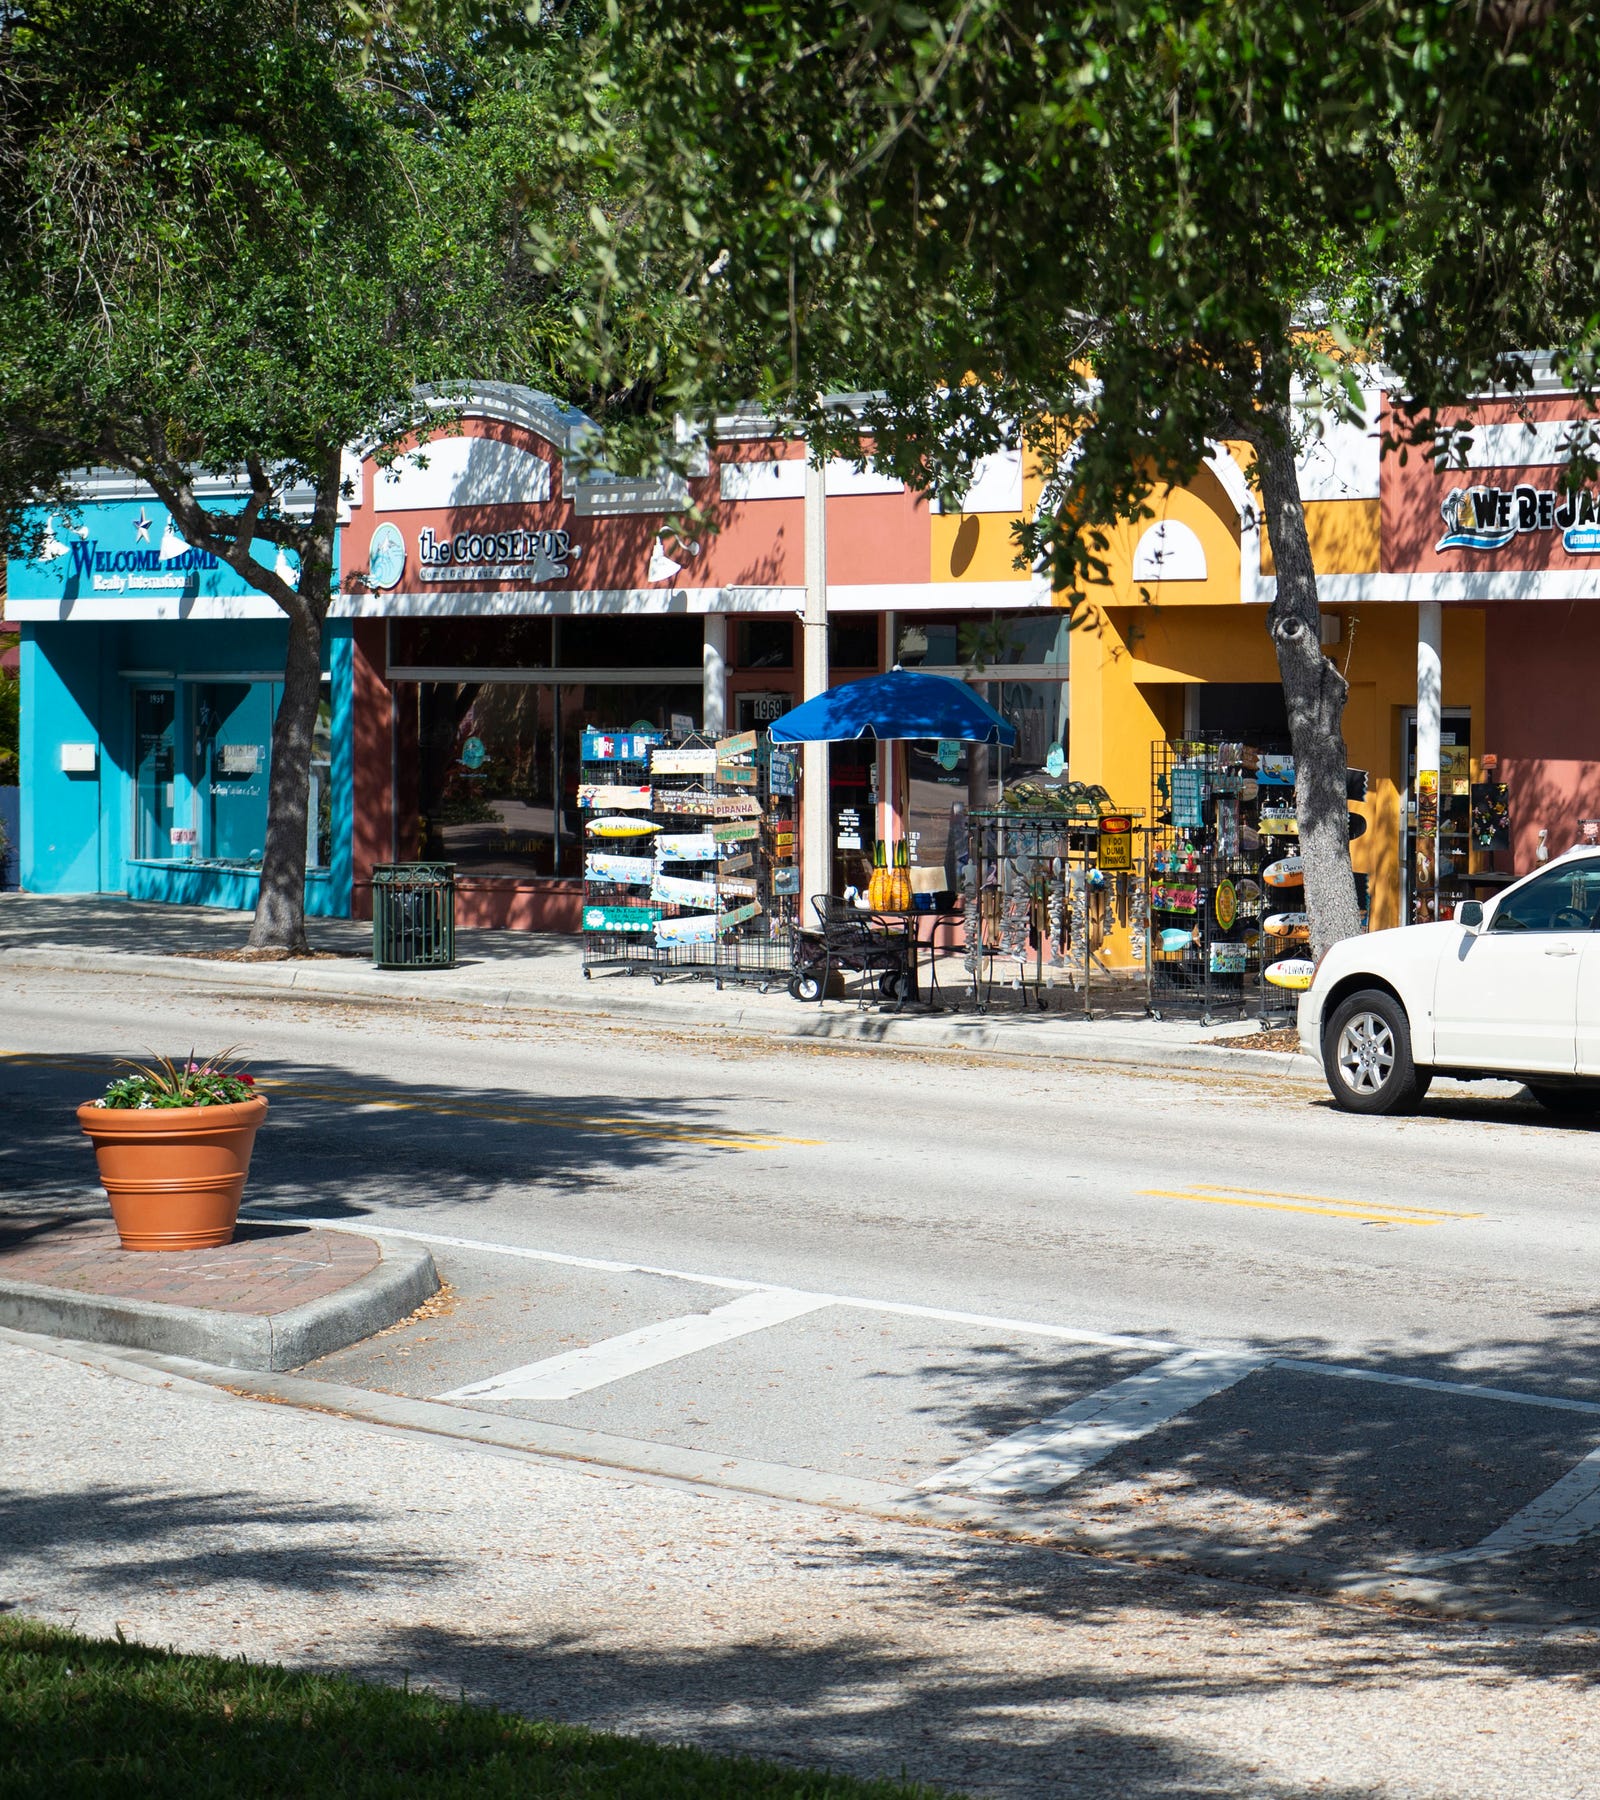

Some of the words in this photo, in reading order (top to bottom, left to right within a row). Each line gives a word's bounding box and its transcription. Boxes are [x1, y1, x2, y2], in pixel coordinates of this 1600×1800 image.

[1473, 489, 1513, 528] WE
[1517, 485, 1555, 528] BE
[420, 528, 449, 561] the
[453, 530, 523, 563] GOOSE
[1569, 534, 1595, 544] VETERAN
[70, 540, 161, 579] WELCOME
[165, 547, 219, 571] HOME
[93, 575, 126, 593] Realty
[128, 573, 194, 590] International
[755, 701, 782, 719] 1969
[716, 804, 753, 814] PIRANHA
[1113, 837, 1122, 846] DO
[1106, 847, 1124, 855] DUMB
[1104, 856, 1126, 864] THINGS
[719, 882, 753, 896] LOBSTER
